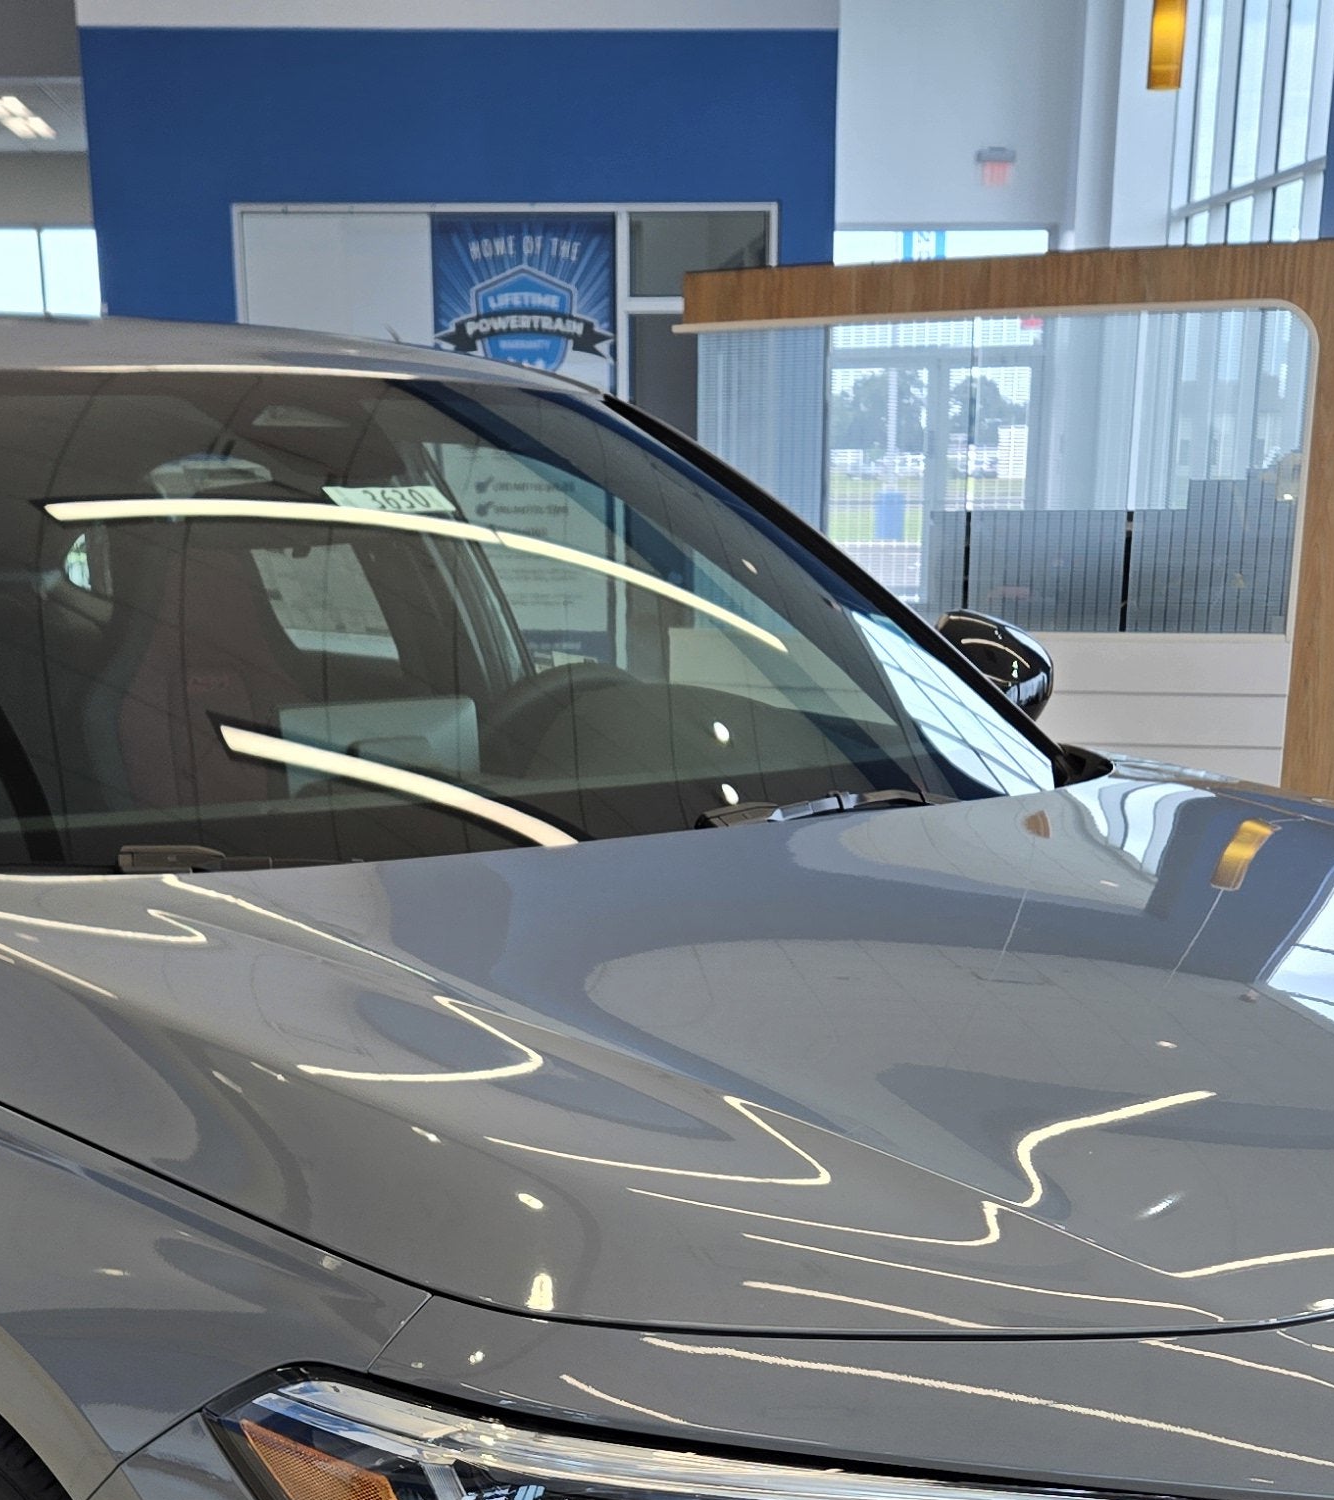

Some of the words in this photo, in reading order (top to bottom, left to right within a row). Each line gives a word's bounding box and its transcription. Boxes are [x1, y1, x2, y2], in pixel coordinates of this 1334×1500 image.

[468, 235, 515, 262] HOME
[522, 235, 543, 257] OF
[549, 237, 582, 262] THE
[488, 291, 560, 310] LIFETIME
[465, 315, 584, 336] POWERTRAIN
[362, 488, 431, 510] 3630
